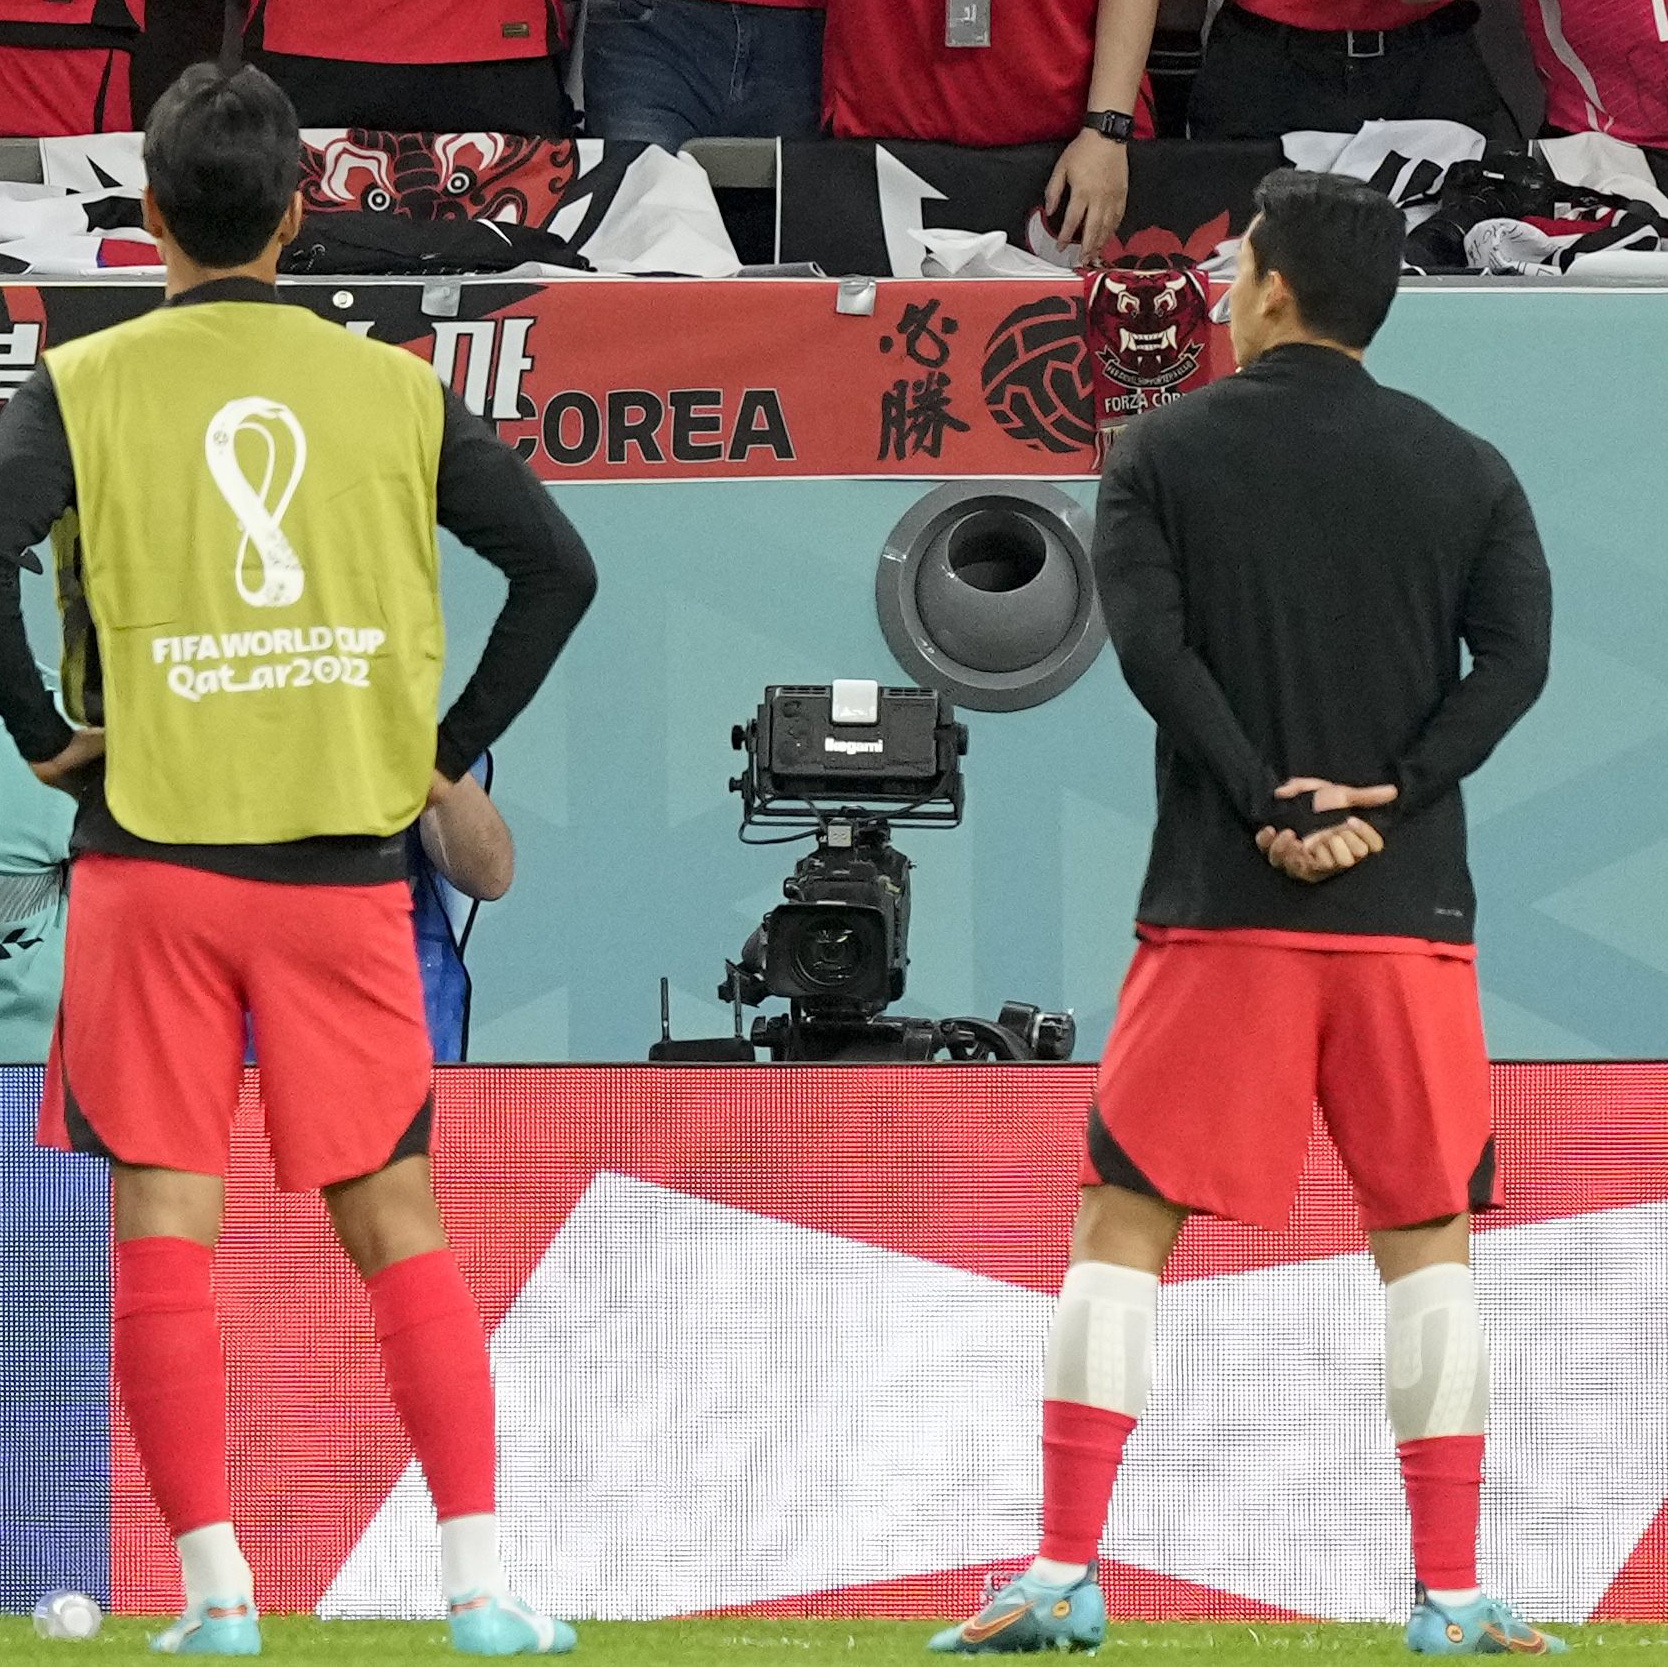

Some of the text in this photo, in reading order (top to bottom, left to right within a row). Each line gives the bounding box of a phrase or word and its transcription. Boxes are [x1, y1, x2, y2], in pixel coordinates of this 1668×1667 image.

[876, 296, 971, 462] 必勝
[1104, 394, 1149, 413] FORZA
[151, 626, 386, 664] FIFA WORLD CUP
[167, 655, 371, 704] Qatar2022
